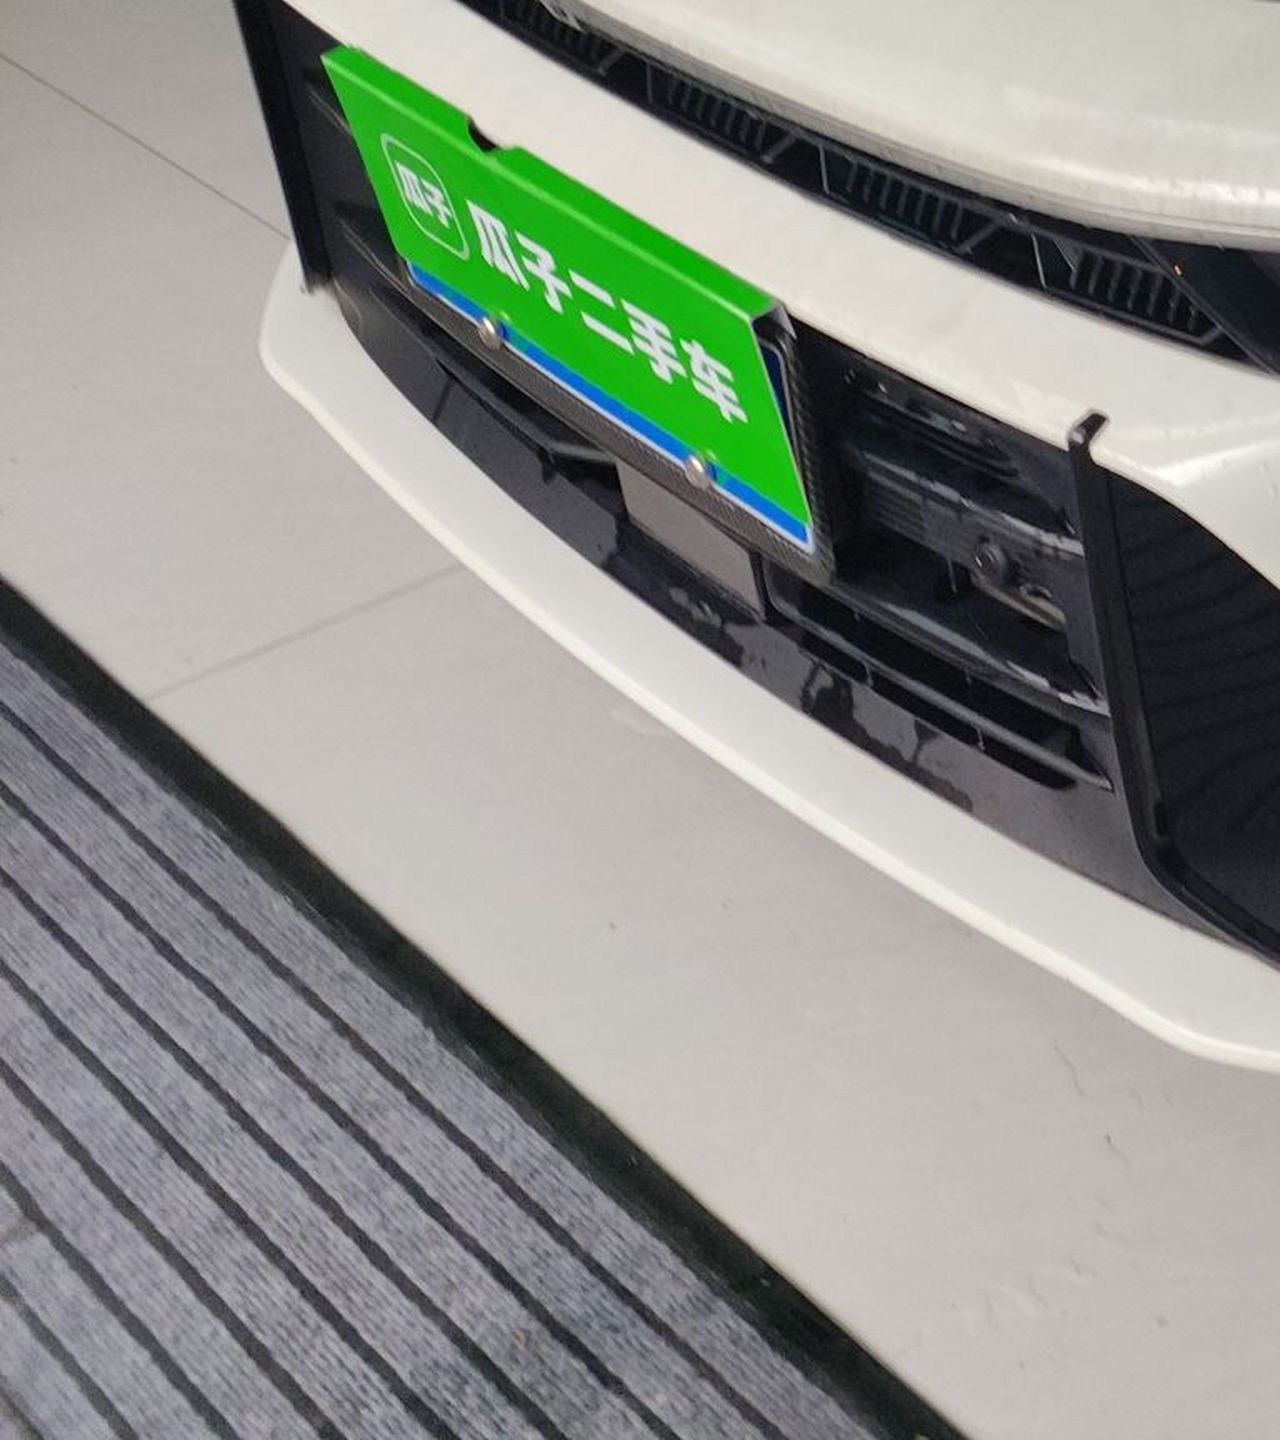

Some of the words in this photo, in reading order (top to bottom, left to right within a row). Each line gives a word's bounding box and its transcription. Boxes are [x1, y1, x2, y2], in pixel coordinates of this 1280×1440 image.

[394, 160, 453, 229] 瓜子
[466, 199, 748, 424] 瓜子二手车
